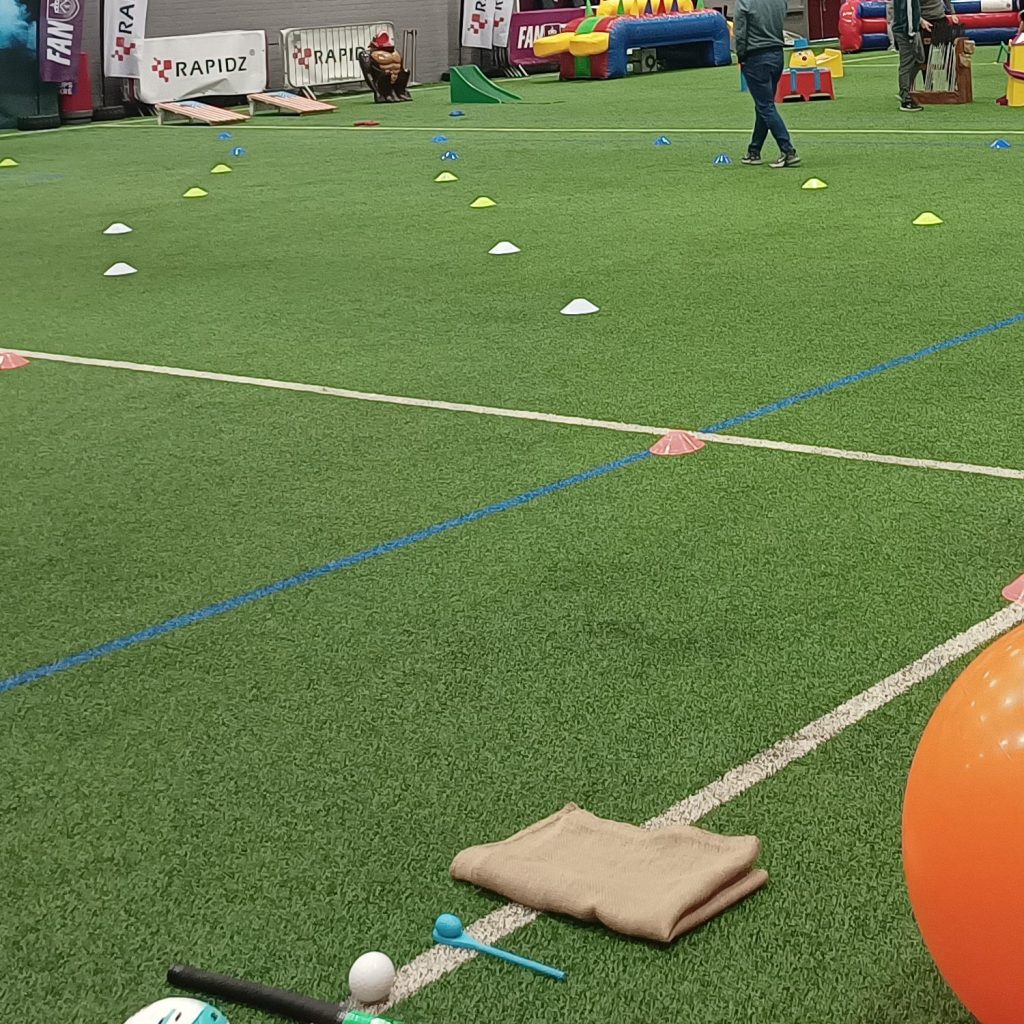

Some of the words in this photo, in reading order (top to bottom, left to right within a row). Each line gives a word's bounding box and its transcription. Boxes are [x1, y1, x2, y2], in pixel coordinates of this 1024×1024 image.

[46, 20, 74, 66] FAN
[313, 46, 366, 65] RAPID
[175, 56, 247, 78] RAPIDZ
